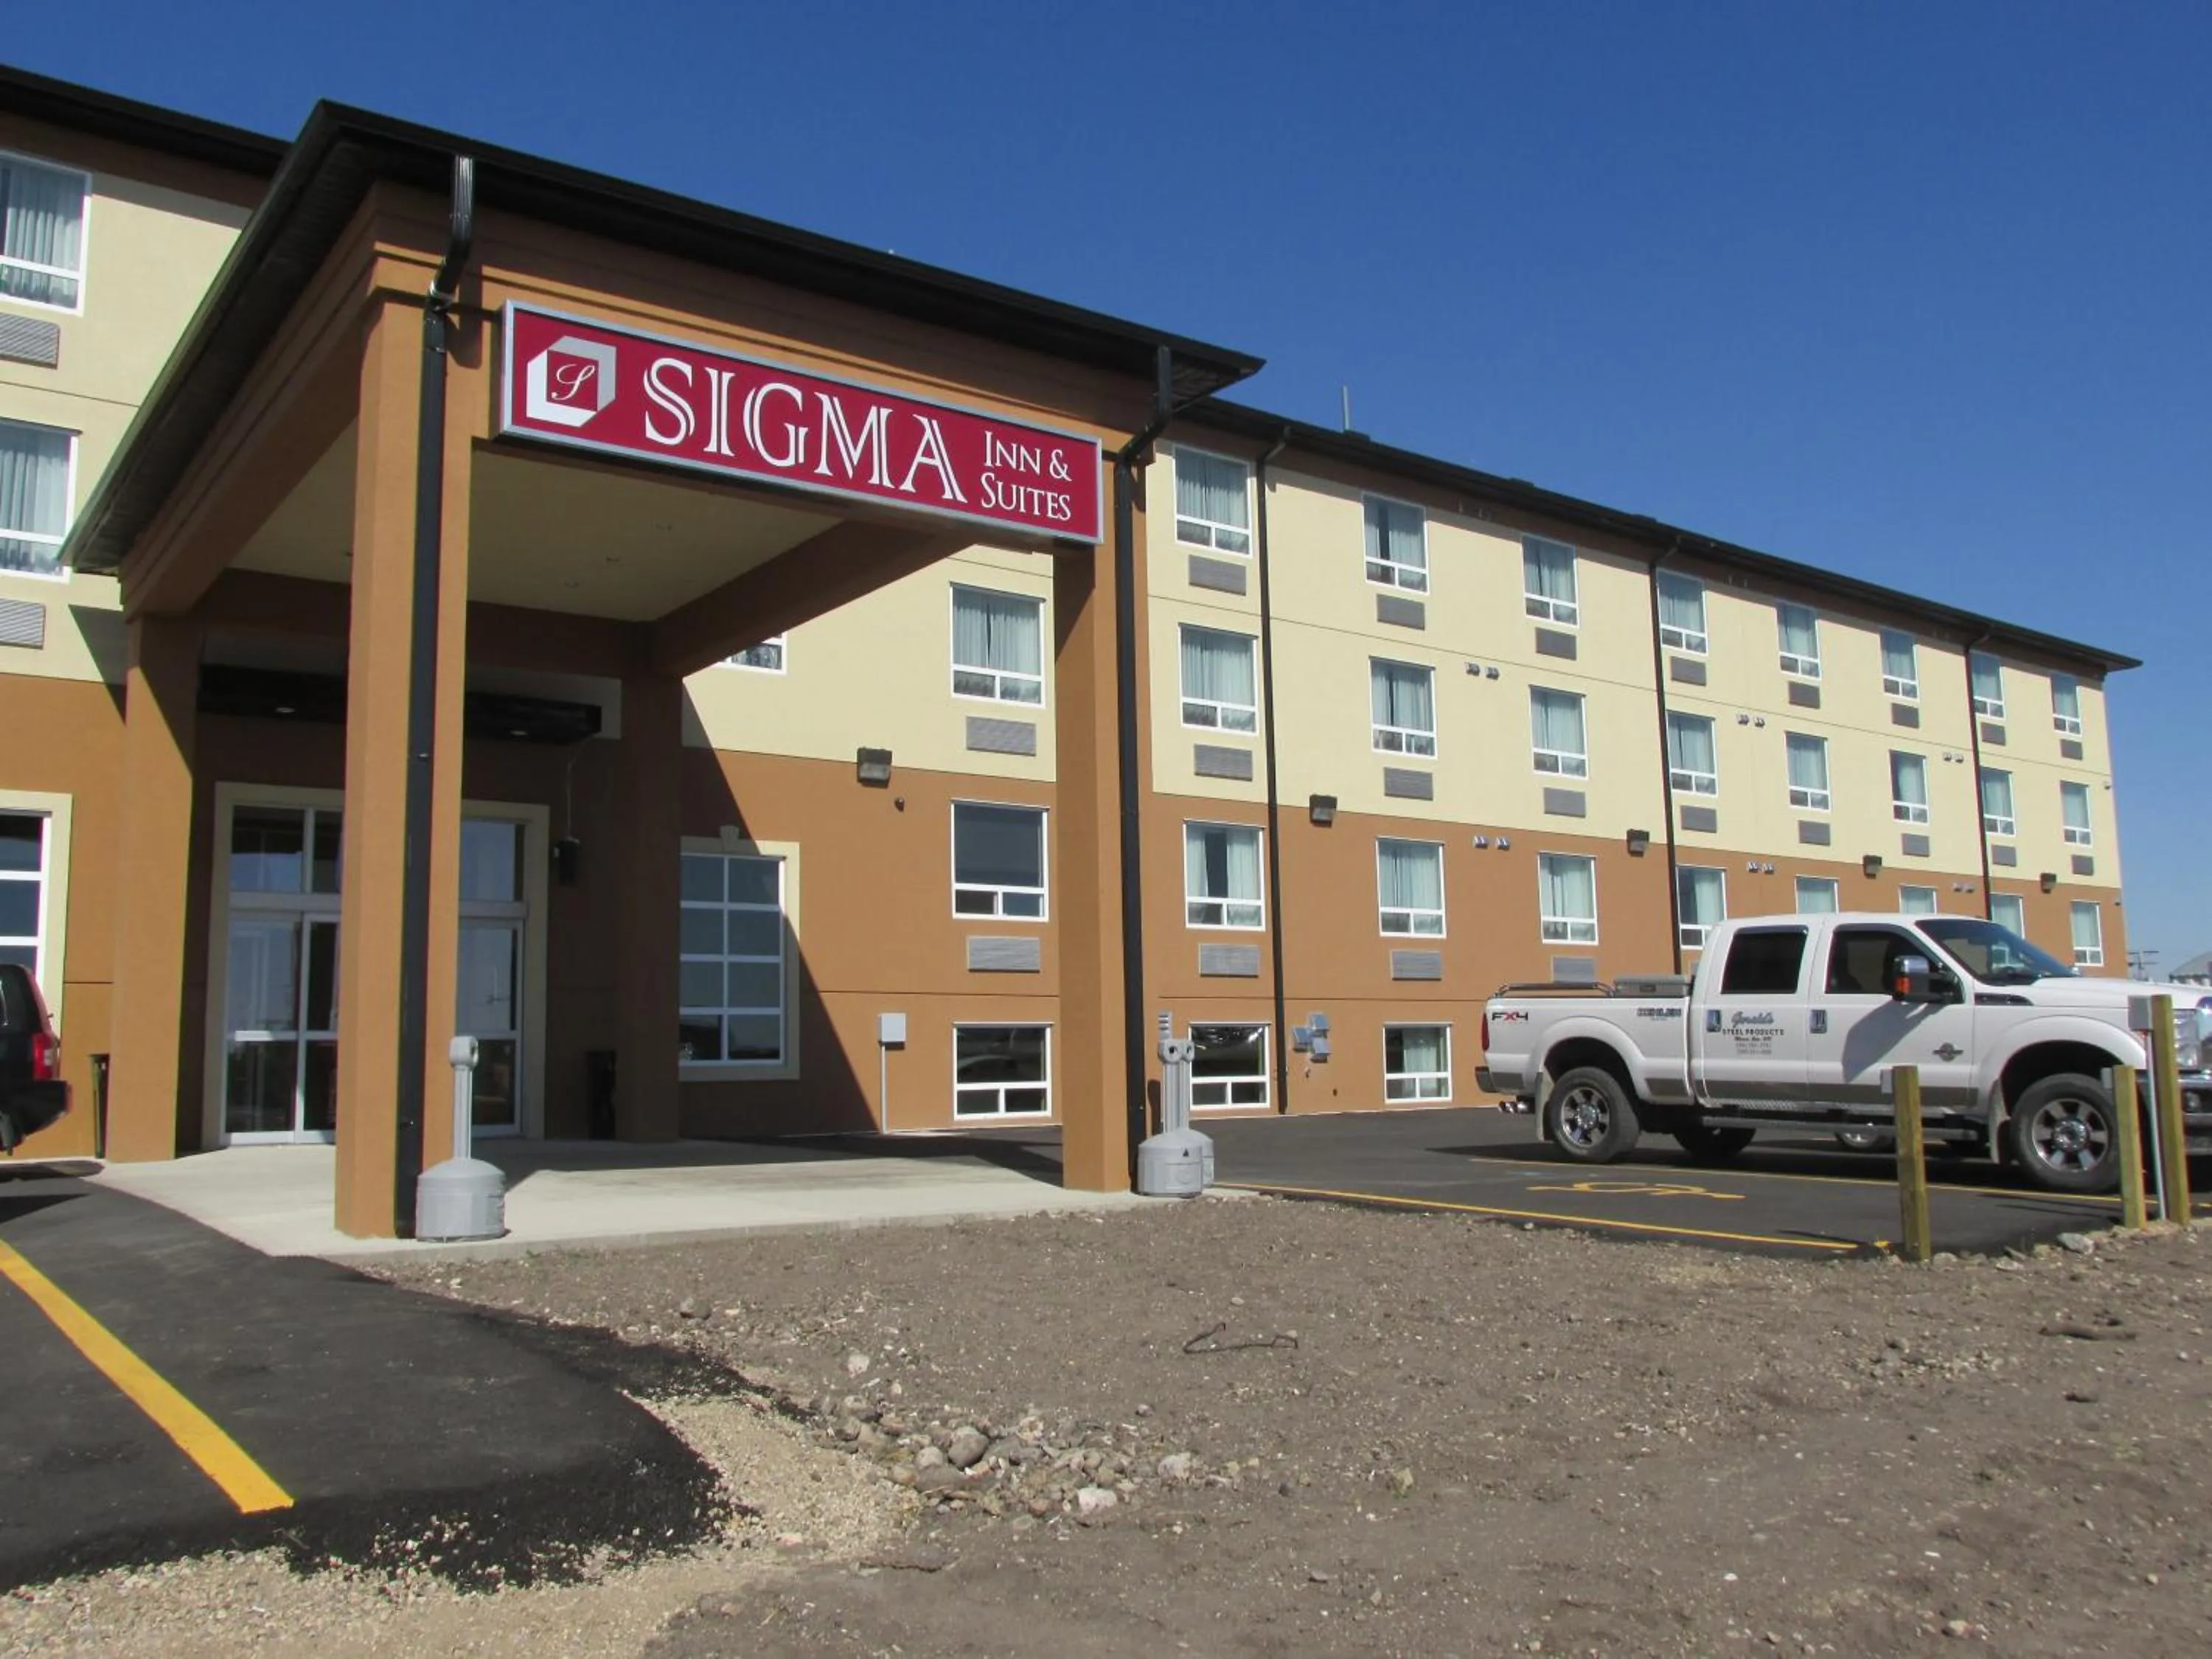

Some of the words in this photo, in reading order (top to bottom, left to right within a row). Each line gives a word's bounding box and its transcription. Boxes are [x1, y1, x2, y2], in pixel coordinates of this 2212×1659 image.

[643, 357, 968, 504] SIGMA
[1049, 448, 1073, 482] &
[980, 471, 1072, 521] SUITES
[1492, 1011, 1528, 1021] FX4
[1722, 1028, 1744, 1036] STEEL
[1745, 1028, 1785, 1036] PRODUCTS
